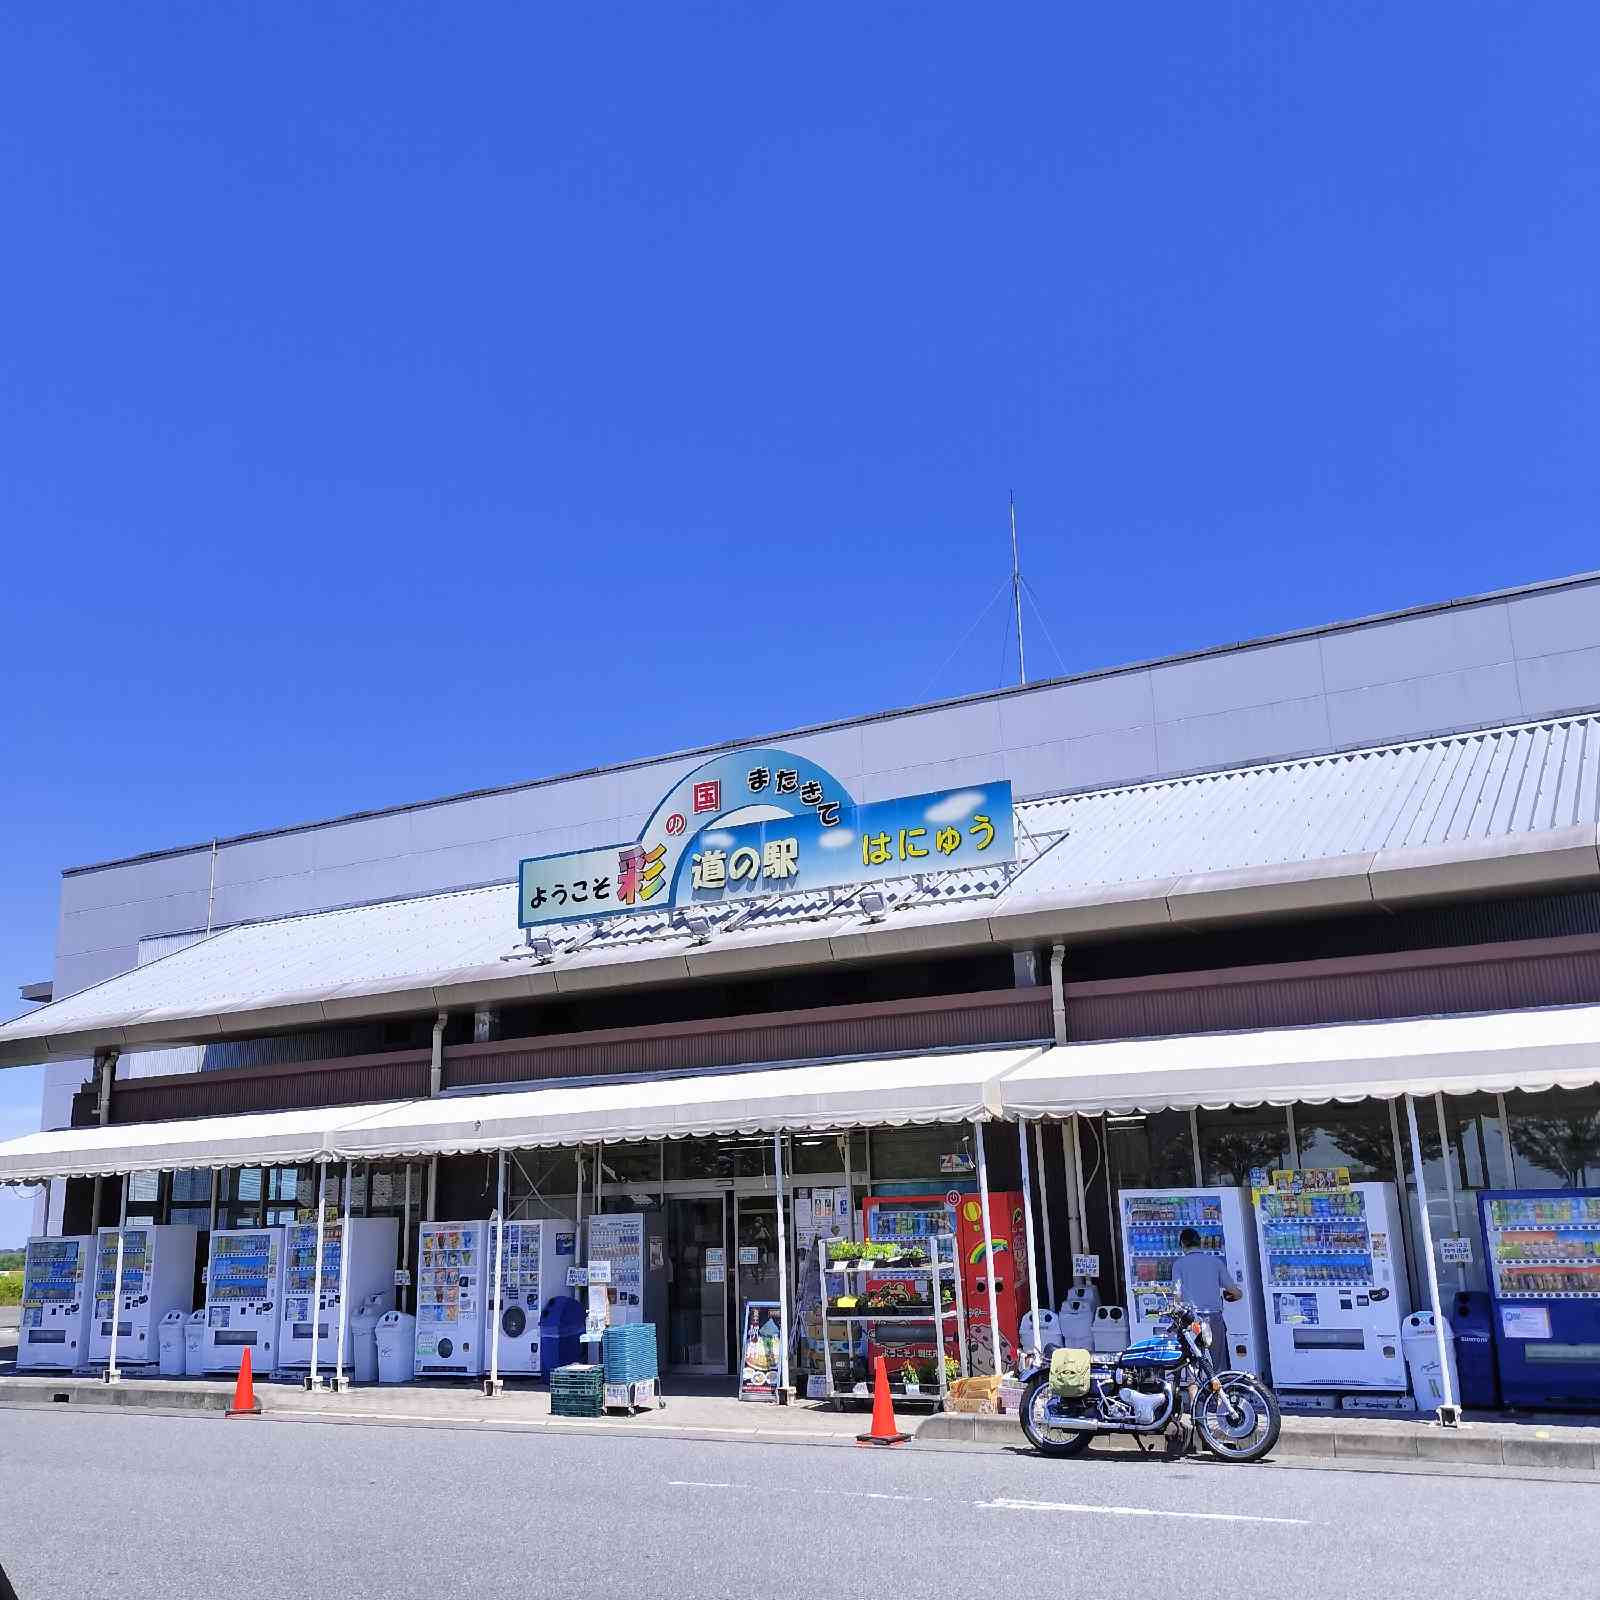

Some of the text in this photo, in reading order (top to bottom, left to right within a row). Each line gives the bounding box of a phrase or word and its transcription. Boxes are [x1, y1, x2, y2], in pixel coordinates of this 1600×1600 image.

[747, 766, 840, 827] またきて
[691, 815, 995, 889] 道の駅 はにゅう
[530, 877, 611, 909] ようこそ
